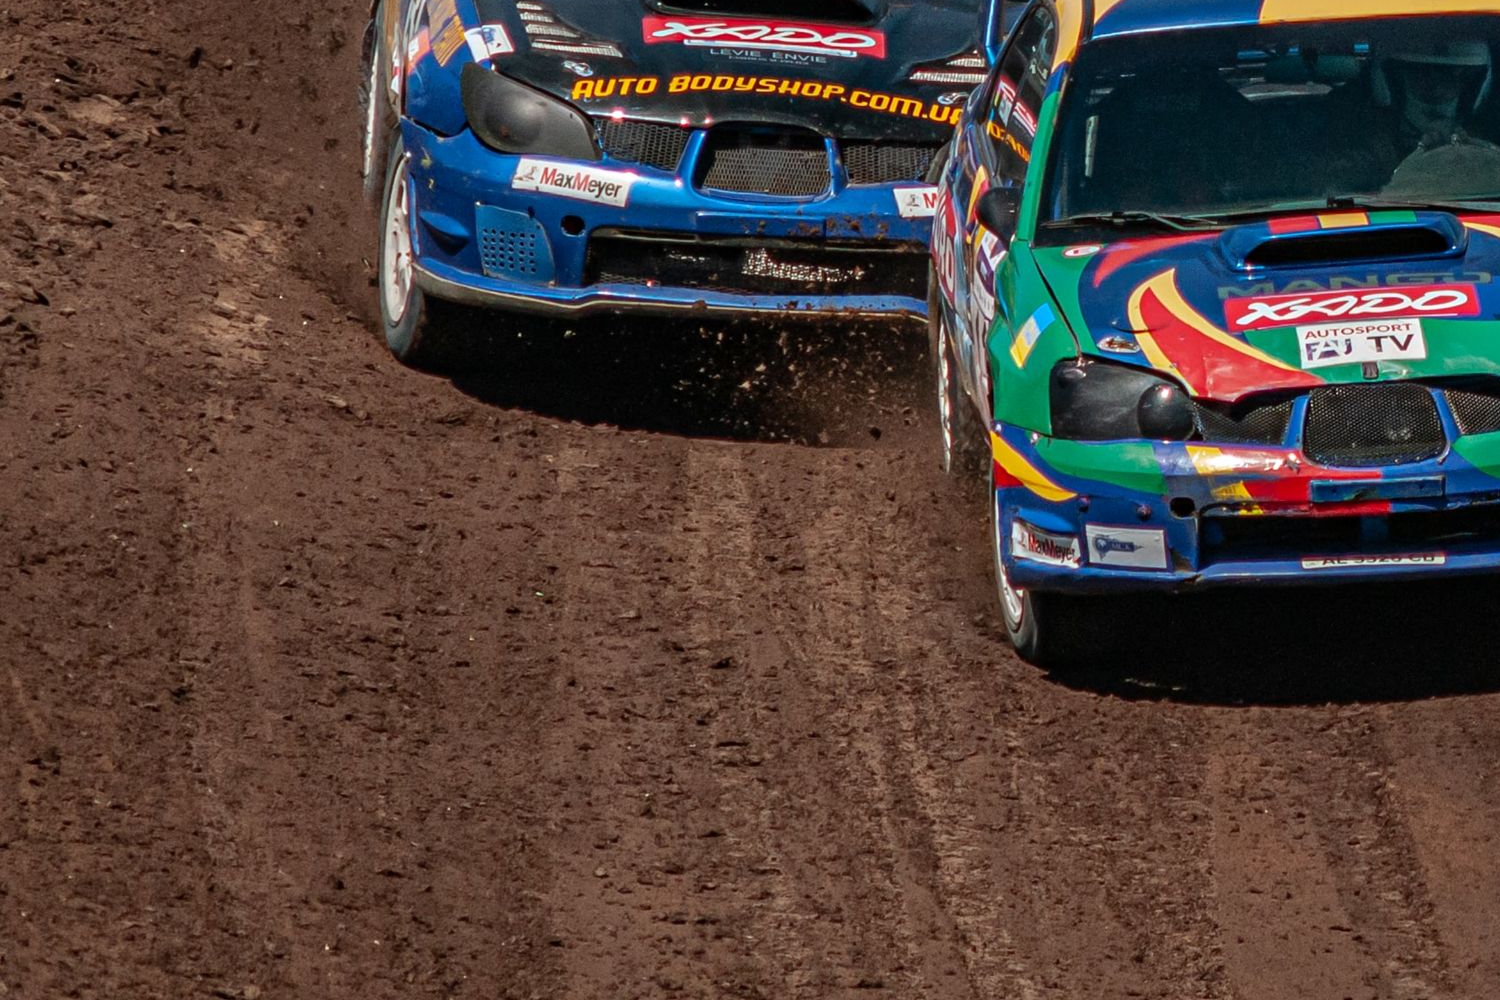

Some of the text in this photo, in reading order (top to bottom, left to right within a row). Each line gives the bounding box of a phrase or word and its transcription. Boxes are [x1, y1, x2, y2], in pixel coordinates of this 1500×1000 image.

[652, 22, 876, 47] XADO
[572, 77, 658, 100] AUTO
[540, 167, 622, 198] MaxMeyer
[1235, 290, 1468, 325] XADO
[1305, 323, 1412, 340] AUTOSPORT
[1367, 334, 1414, 353] TV
